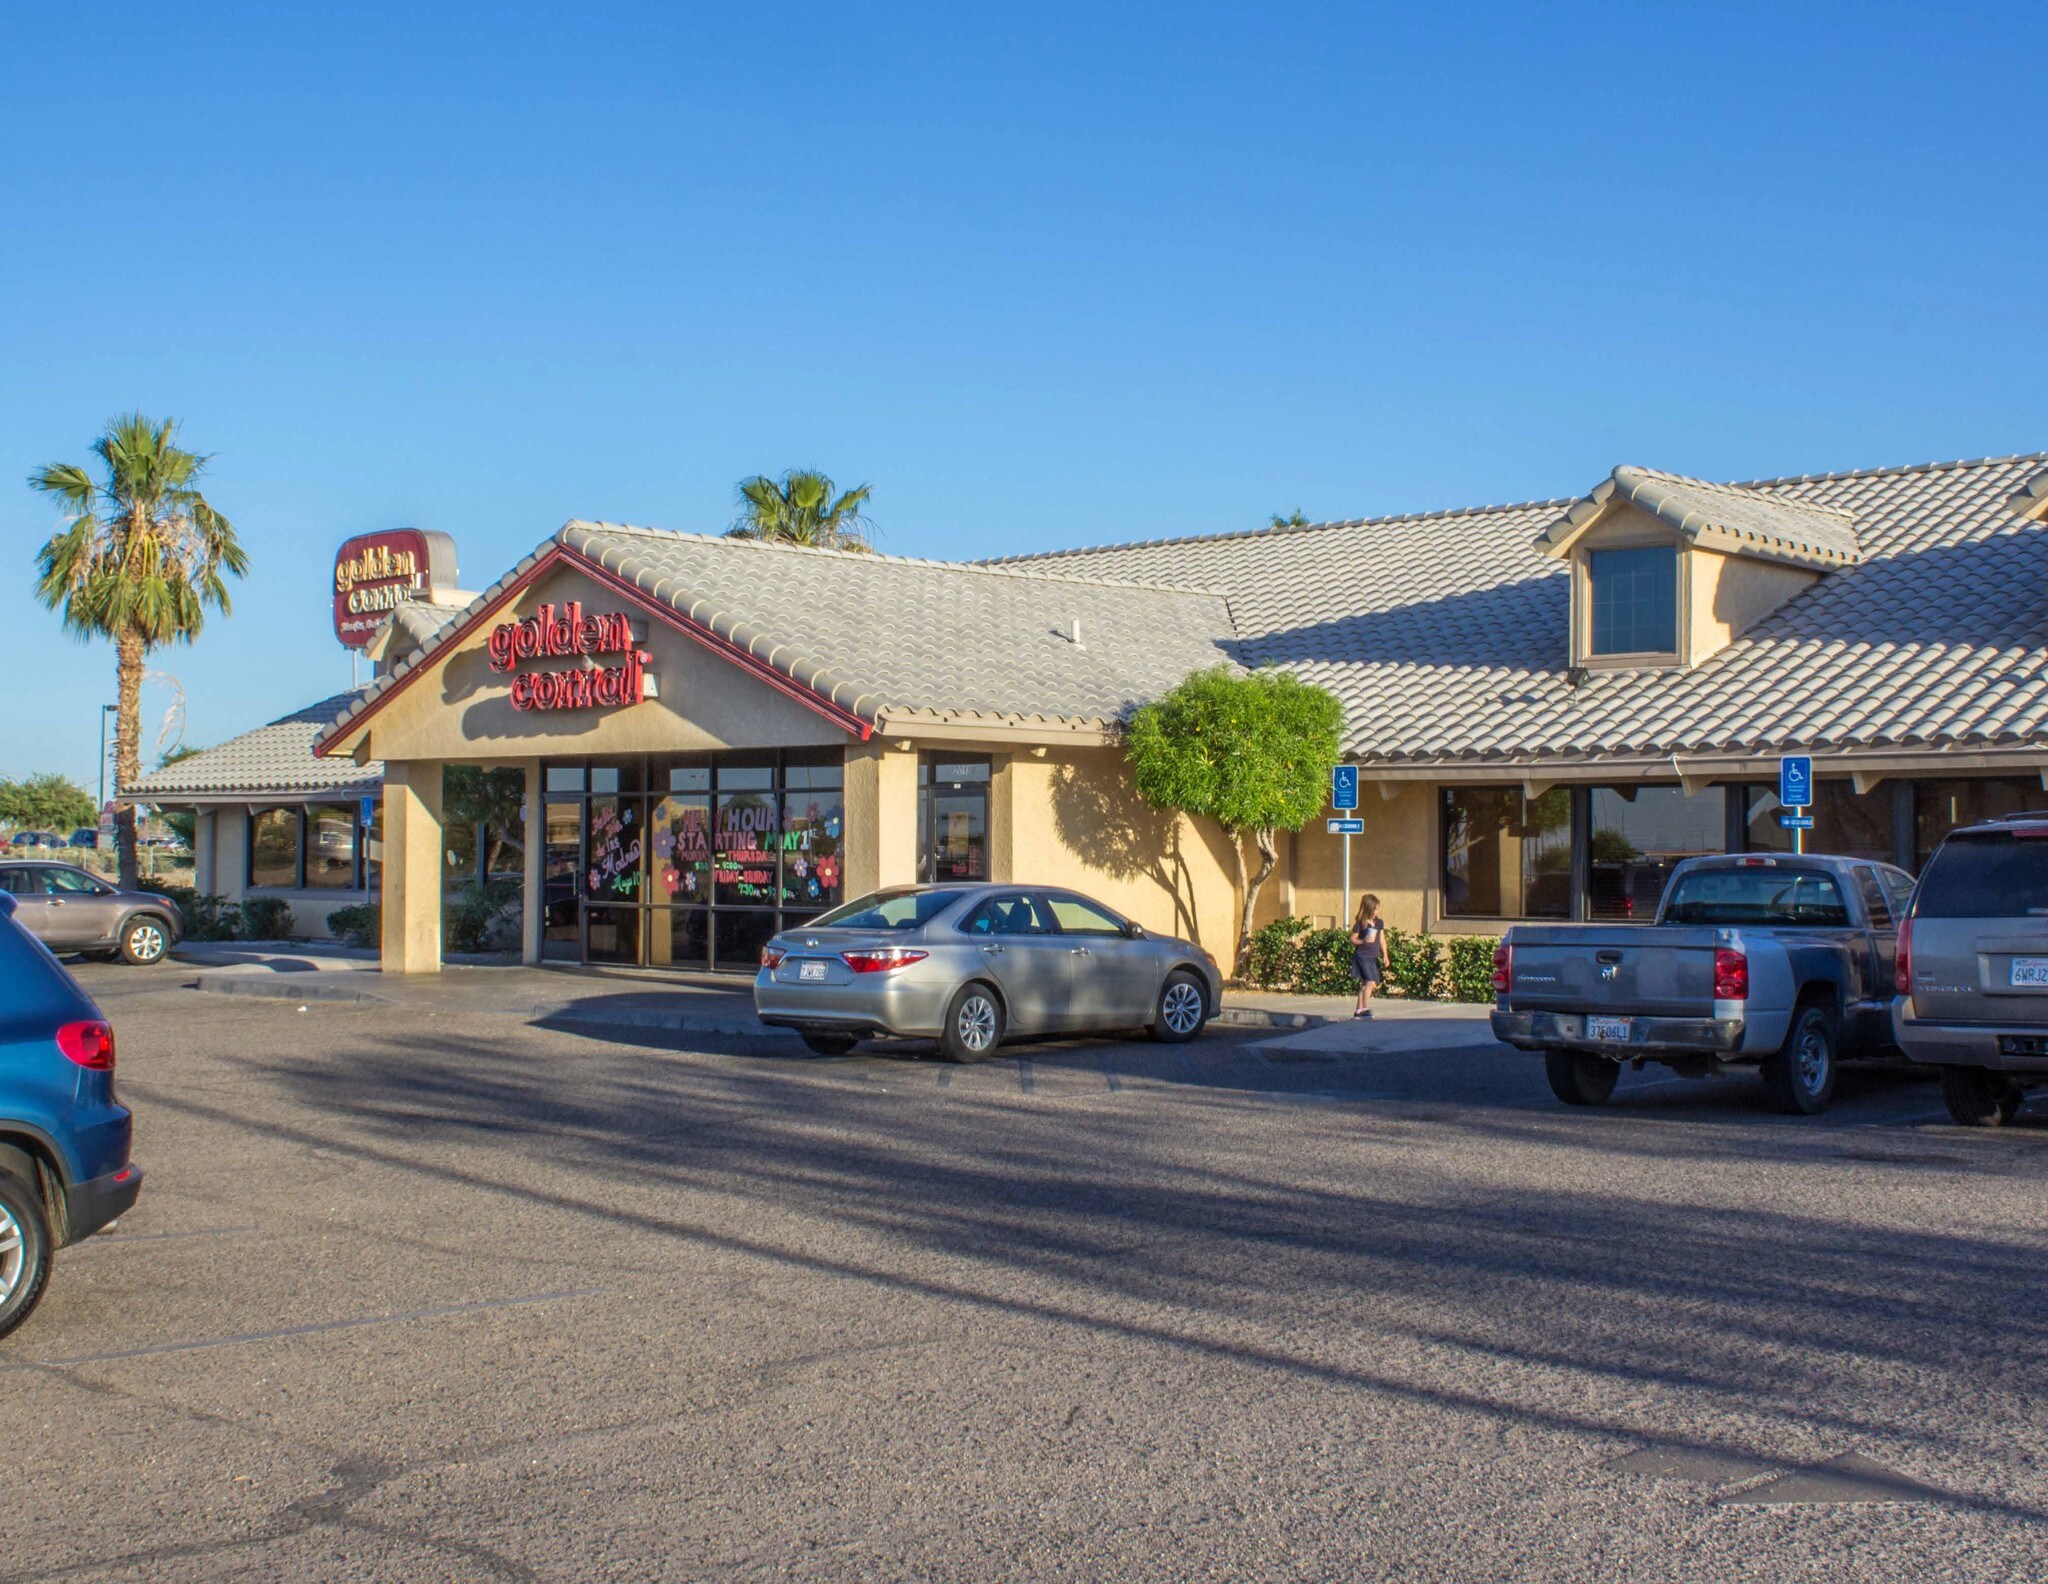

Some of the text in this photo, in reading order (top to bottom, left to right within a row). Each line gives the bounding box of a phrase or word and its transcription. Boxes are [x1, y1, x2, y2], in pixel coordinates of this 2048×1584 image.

[336, 545, 416, 593] golden
[489, 601, 632, 673] golden
[510, 650, 644, 712] corral
[677, 831, 758, 850] STARTING
[764, 830, 801, 850] MAY
[2014, 967, 2048, 982] 6WRJ2
